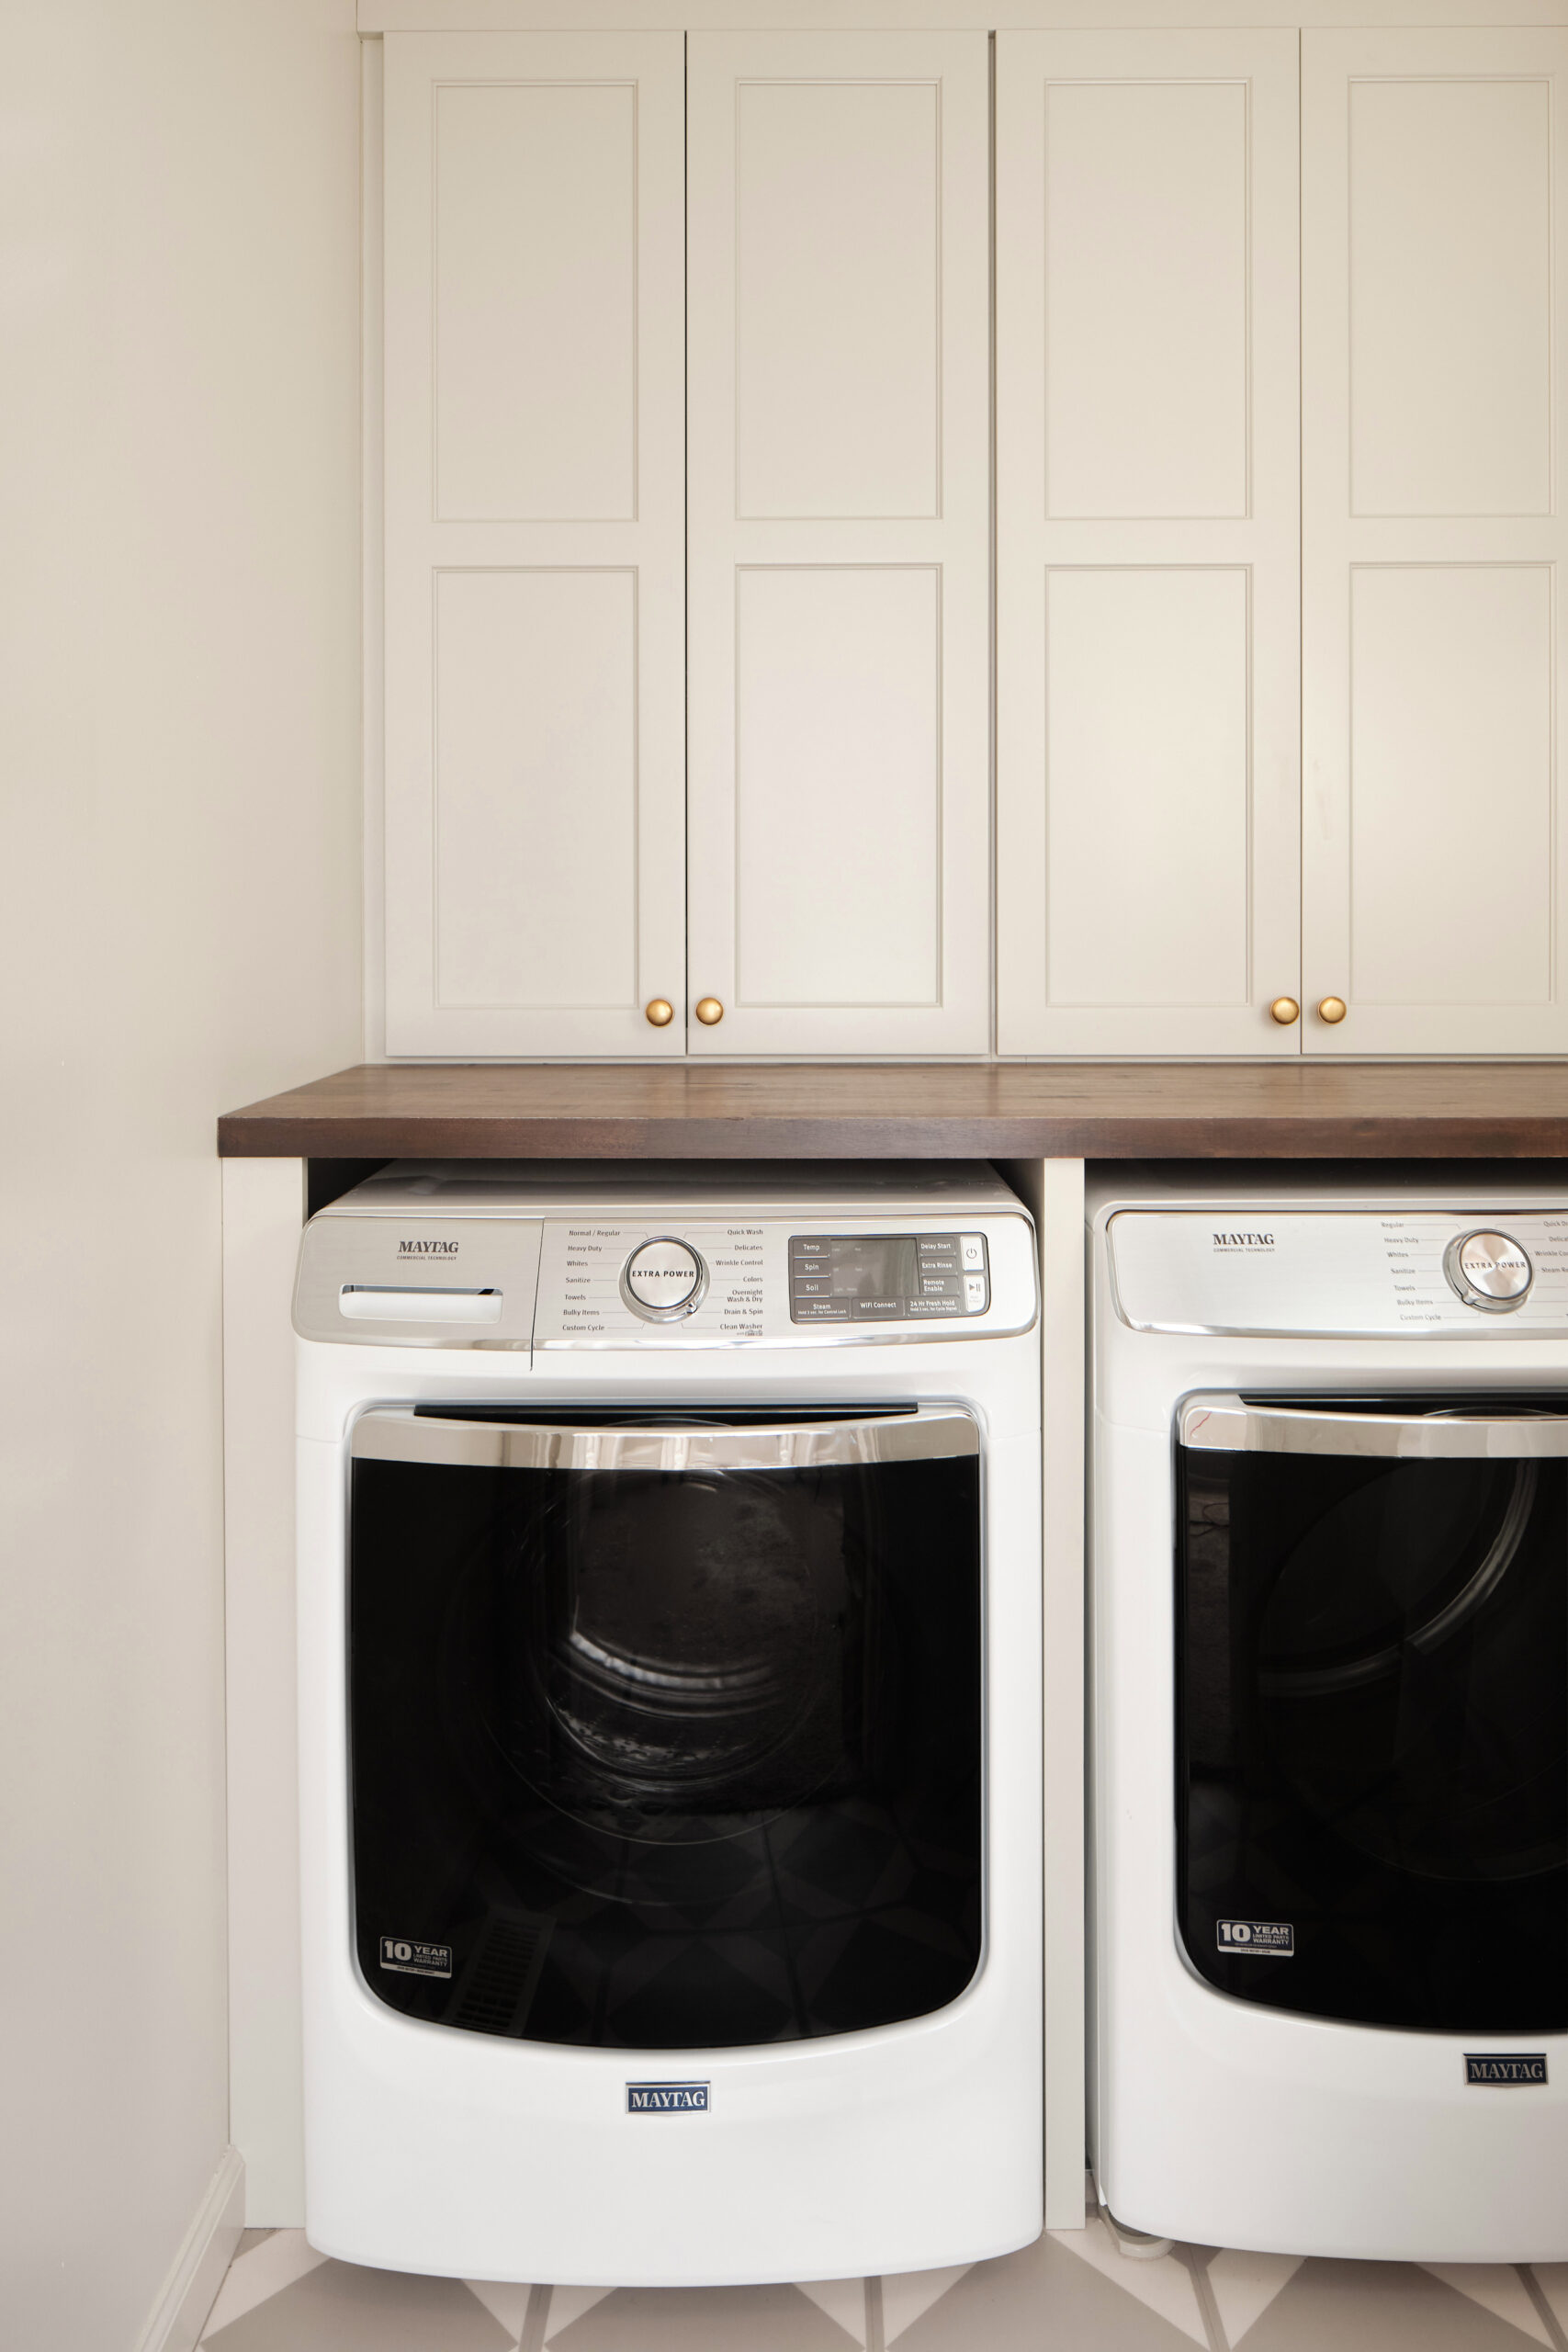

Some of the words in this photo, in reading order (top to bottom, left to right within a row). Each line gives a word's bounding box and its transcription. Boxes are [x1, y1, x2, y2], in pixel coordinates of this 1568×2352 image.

[1213, 1234, 1275, 1245] MAYTAG
[398, 1241, 459, 1253] MAYTAG
[803, 1244, 820, 1252] Temp
[805, 1263, 819, 1272] Spin
[1221, 1923, 1250, 1941] 10
[1253, 1926, 1289, 1935] YEAR
[384, 1940, 412, 1961] 10
[414, 1945, 448, 1957] YEAR
[413, 1958, 447, 1966] WARRANTY
[1470, 2063, 1543, 2079] MAYTAG
[631, 2091, 705, 2108] MAYTAG
